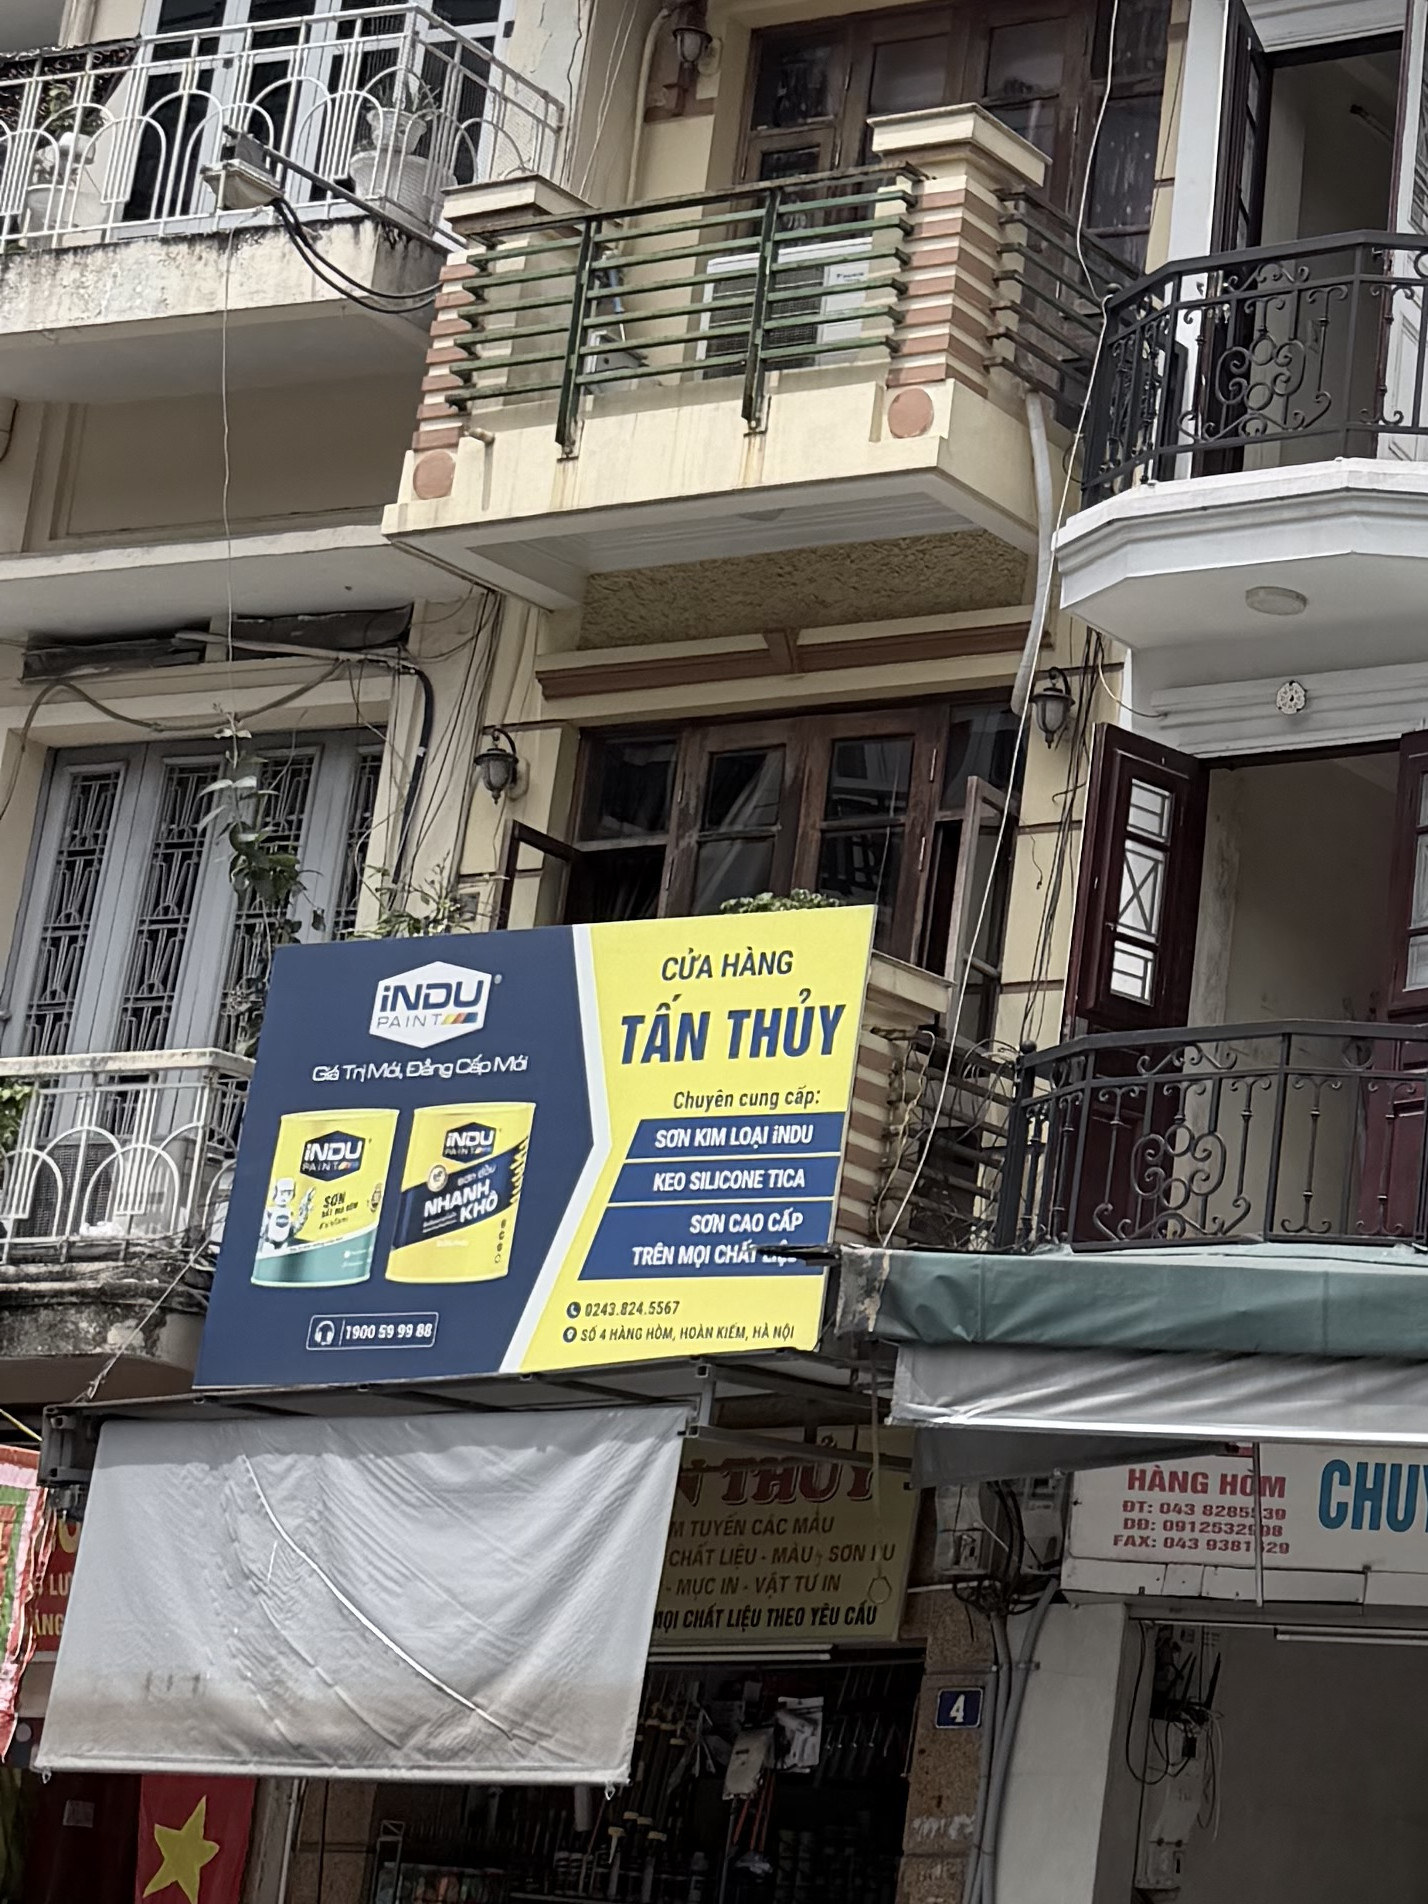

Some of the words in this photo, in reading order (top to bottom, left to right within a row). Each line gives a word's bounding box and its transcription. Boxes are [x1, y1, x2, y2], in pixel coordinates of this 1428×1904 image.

[661, 947, 713, 981] CỬA
[721, 946, 794, 978] HÀNG
[376, 1013, 442, 1029] PAINT
[621, 994, 711, 1065] TẤN
[727, 988, 847, 1060] THỦY
[312, 1064, 340, 1082] Giá
[673, 1089, 734, 1113] Chuyên
[739, 1094, 779, 1111] cung
[784, 1085, 821, 1110] cấp:
[655, 1127, 691, 1149] SƠN
[694, 1127, 725, 1147] KIM
[730, 1126, 769, 1149] LOẠI
[653, 1172, 686, 1192] KEO
[689, 1169, 765, 1191] SILICONE
[768, 1168, 806, 1189] TICA
[423, 1179, 490, 1218] NHANH
[459, 1189, 498, 1224] KHÔ
[690, 1214, 725, 1234] SƠN
[729, 1213, 764, 1232] CAO
[768, 1206, 804, 1231] CẤP
[632, 1241, 675, 1266] TRÊN
[678, 1246, 710, 1269] MỌI
[714, 1239, 757, 1265] CHẤT
[585, 1300, 680, 1317] 0243.824.5567
[345, 1325, 376, 1340] 1900
[580, 1325, 597, 1342] SỐ
[600, 1328, 606, 1340] 4
[609, 1324, 643, 1341] HÀNG
[680, 1324, 714, 1340] HOÀN
[752, 1323, 770, 1339] HÀ
[773, 1323, 795, 1342] NỘI
[1127, 1464, 1209, 1494] HÀNG
[1159, 1502, 1196, 1516] 043
[751, 1514, 788, 1536] CÁC
[669, 1540, 715, 1566] CHẤT
[719, 1543, 757, 1569] LIỆU
[772, 1541, 813, 1564] MÀU
[829, 1544, 866, 1562] SƠN
[1113, 1534, 1157, 1548] FAX:
[1163, 1537, 1199, 1550] 043
[676, 1576, 716, 1600] MỰC
[720, 1576, 739, 1594] IN
[756, 1571, 790, 1599] VẬT
[795, 1573, 819, 1592] TƯ
[822, 1574, 841, 1591] IN
[683, 1603, 724, 1629] CHẤT
[727, 1604, 762, 1632] LIỆU
[767, 1607, 805, 1627] THEO
[811, 1602, 840, 1627] YÊU
[950, 1693, 965, 1723] 4
